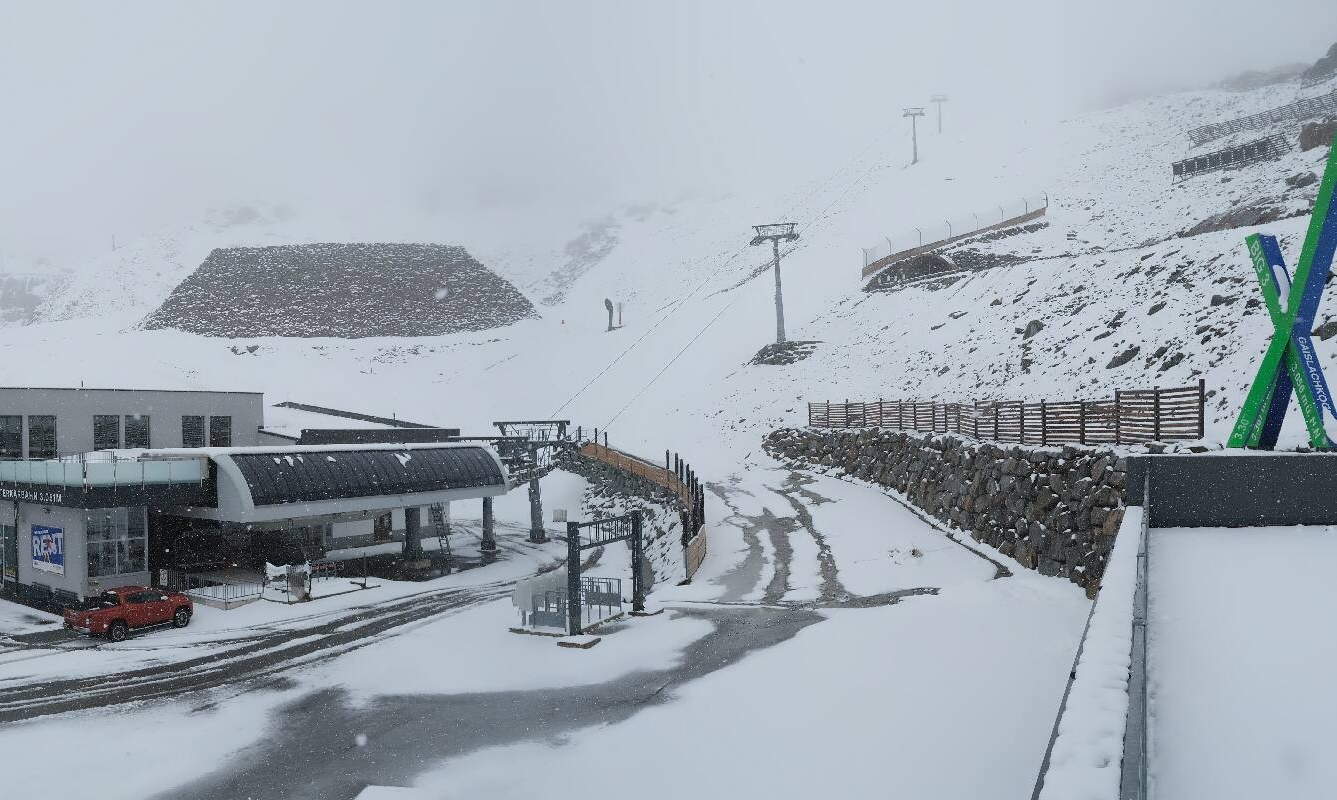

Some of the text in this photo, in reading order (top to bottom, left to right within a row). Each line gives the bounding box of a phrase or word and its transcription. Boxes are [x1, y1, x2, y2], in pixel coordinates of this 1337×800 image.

[1250, 240, 1270, 287] BIG 3
[1298, 336, 1331, 411] GAISLACHKOG
